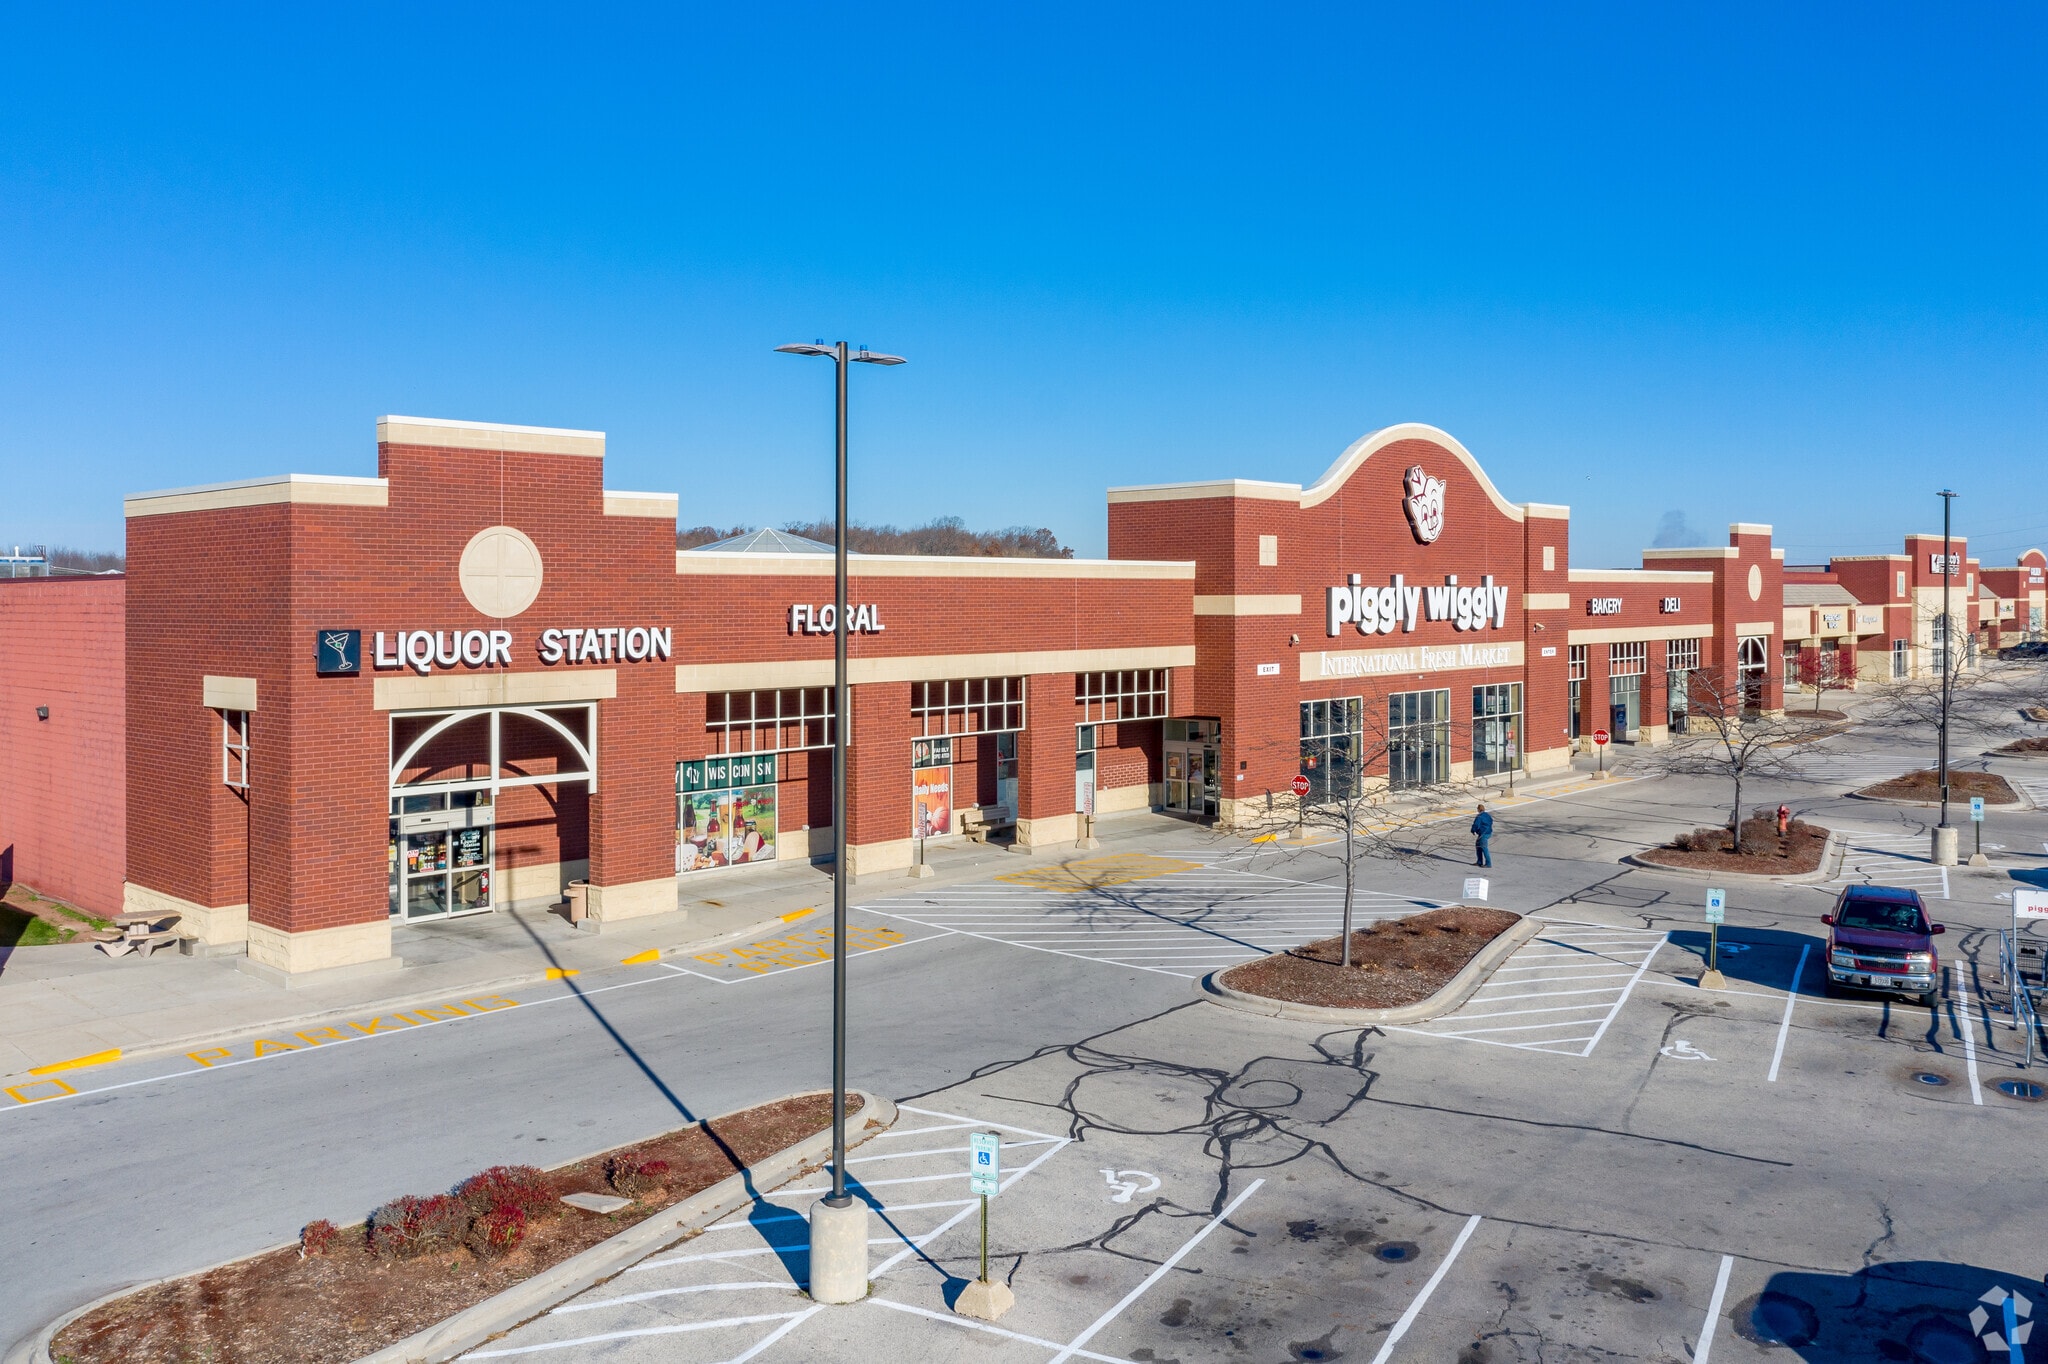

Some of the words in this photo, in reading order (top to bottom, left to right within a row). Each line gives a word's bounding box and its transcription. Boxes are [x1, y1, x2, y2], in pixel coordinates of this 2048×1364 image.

[792, 603, 886, 632] FLORAL
[1328, 573, 1421, 636] piggly
[1424, 574, 1509, 631] wiggly
[1592, 598, 1623, 614] BAKERY
[1664, 597, 1681, 612] DELI
[374, 629, 513, 673] LIQUOR
[539, 626, 673, 663] STATION
[1319, 651, 1417, 678] INTERNATIONAL
[1420, 645, 1457, 673] FRESH
[1460, 643, 1511, 668] MARKET
[1292, 781, 1309, 791] STOP
[185, 994, 521, 1068] PARKING
